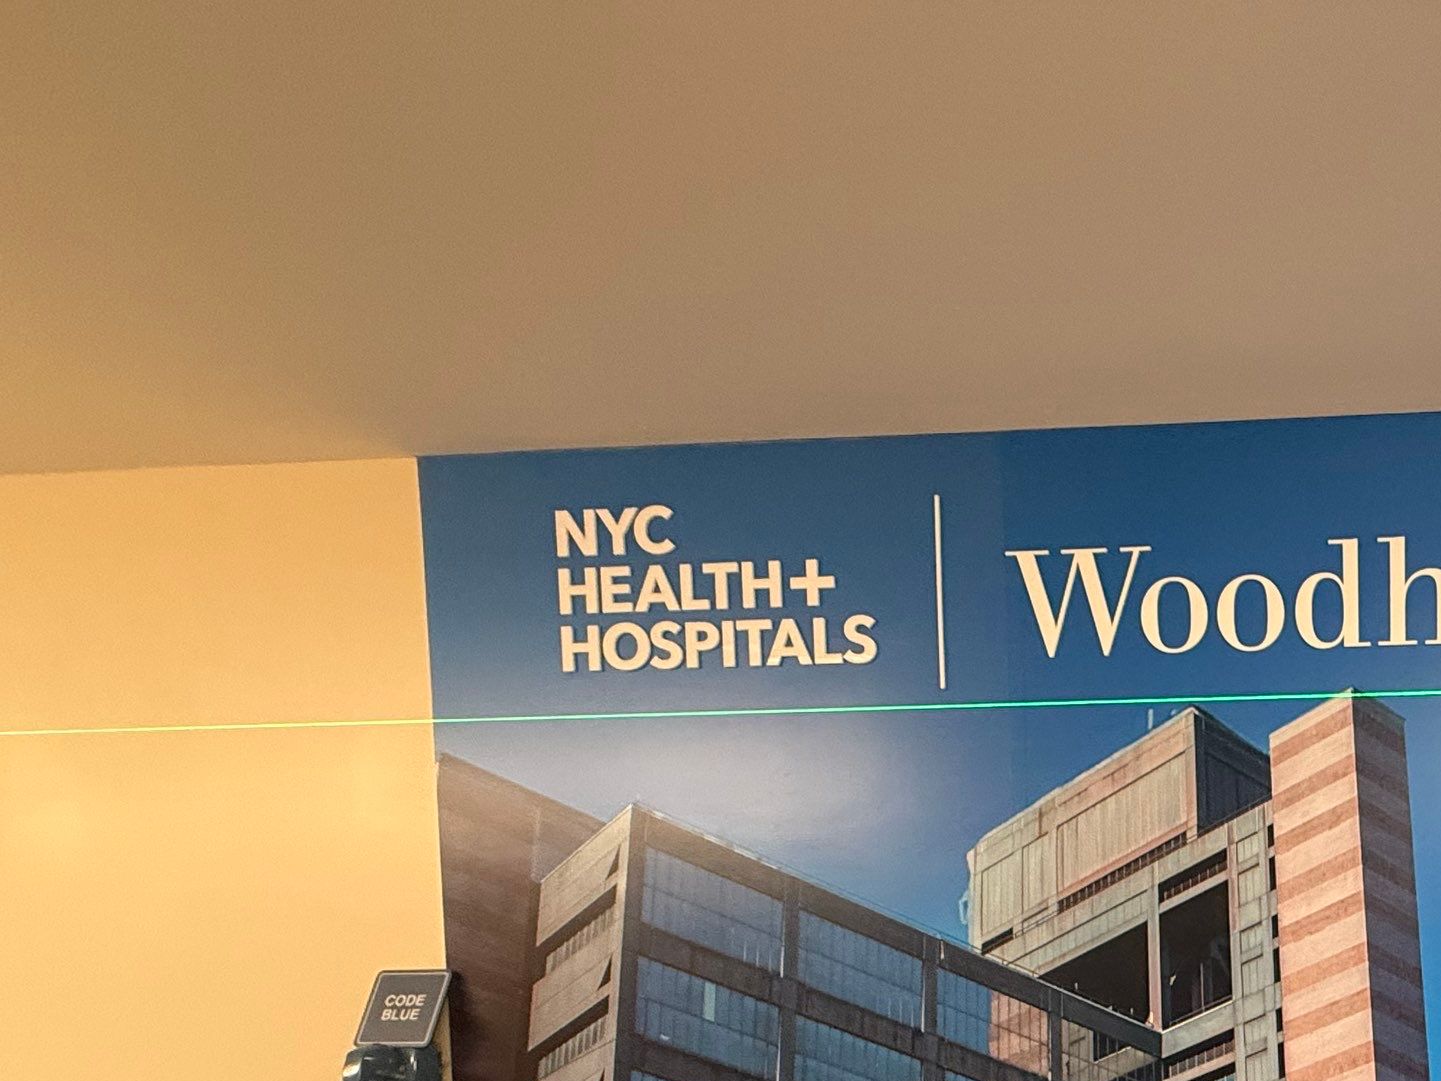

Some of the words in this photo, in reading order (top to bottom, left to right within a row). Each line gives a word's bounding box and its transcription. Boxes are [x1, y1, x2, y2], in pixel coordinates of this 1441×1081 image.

[555, 505, 675, 557] NYC
[558, 559, 835, 613] HEALTH+
[560, 615, 877, 672] HOSPITALS
[381, 1009, 420, 1020] BLUE
[385, 995, 426, 1006] CODE
